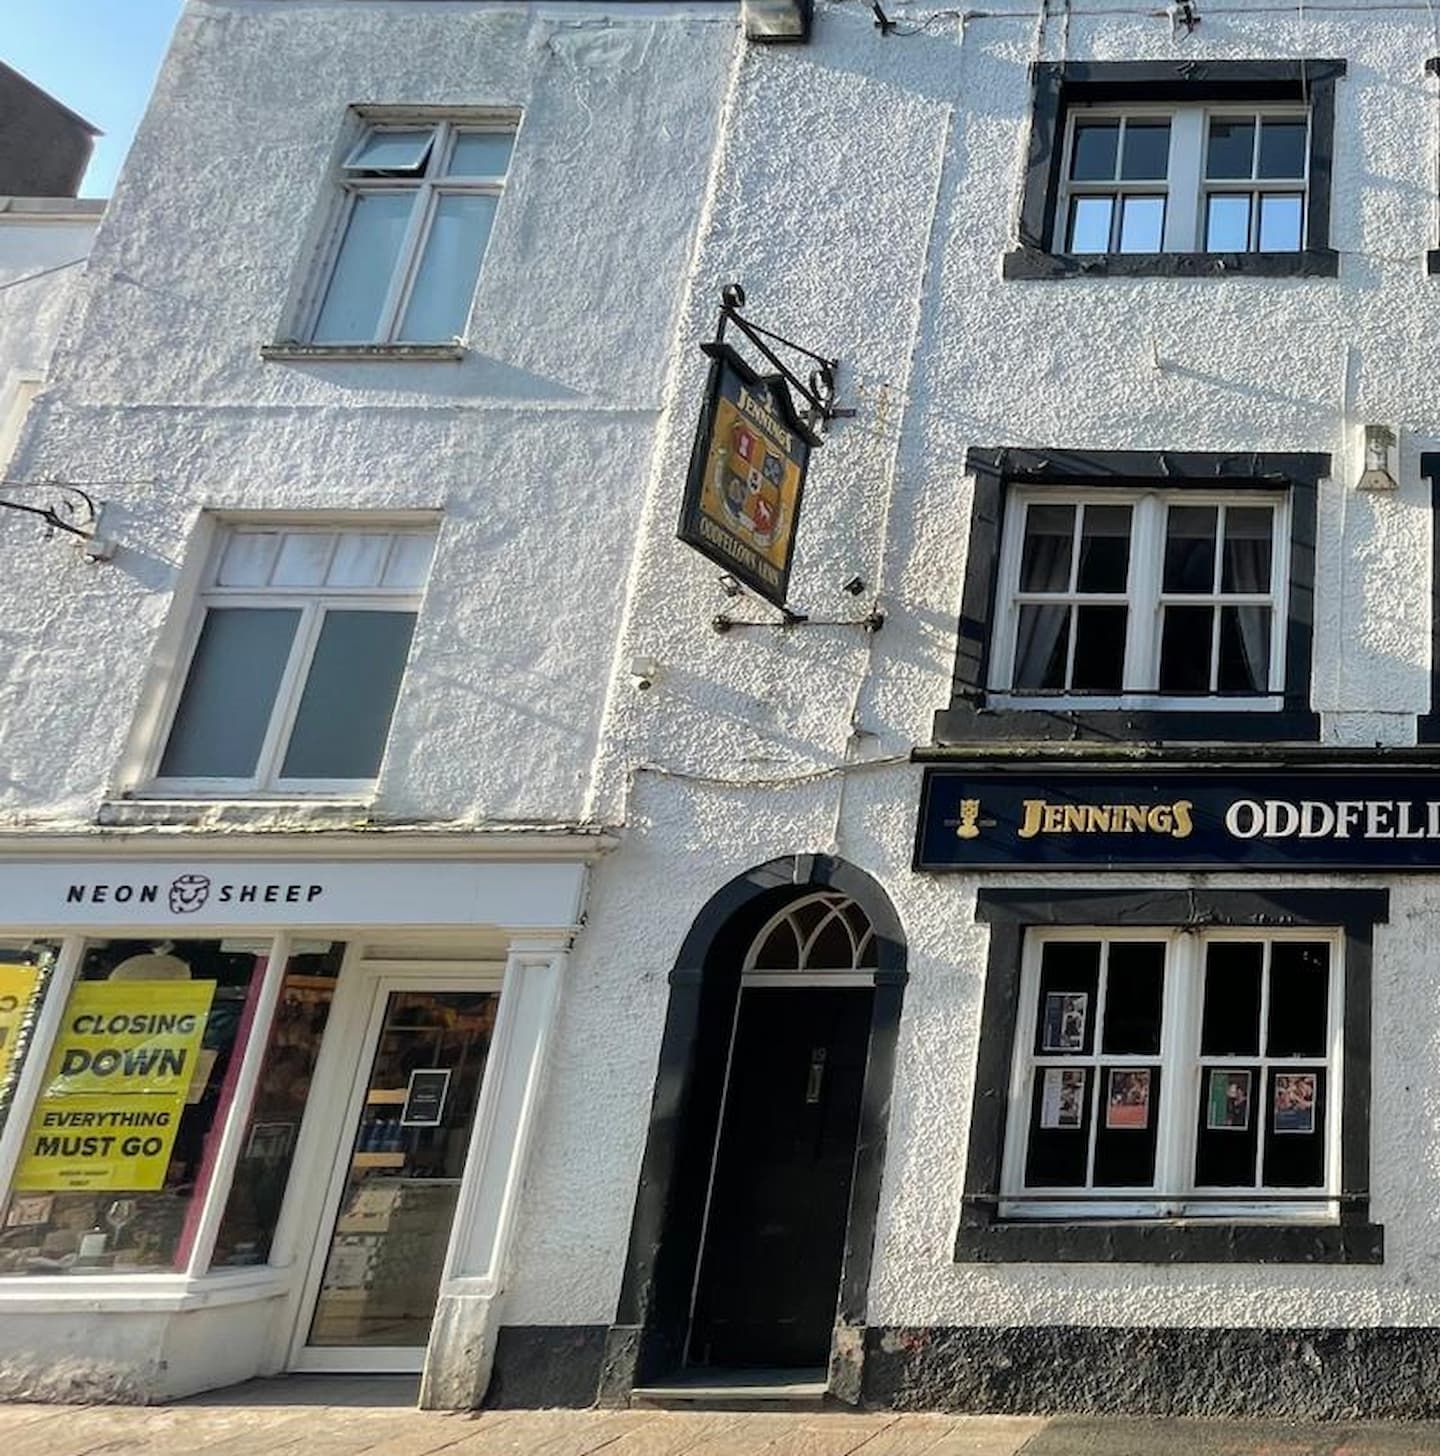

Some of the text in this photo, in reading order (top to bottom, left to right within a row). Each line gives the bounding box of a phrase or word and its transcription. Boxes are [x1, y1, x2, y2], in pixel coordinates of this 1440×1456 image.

[737, 387, 793, 453] JENNINGS
[1018, 799, 1193, 839] JENNINGS
[66, 884, 324, 903] NEON SHEEP
[72, 1014, 197, 1036] CLOSING
[61, 1048, 188, 1077] DOWN
[42, 1111, 171, 1128] EVERYTHING
[34, 1136, 164, 1158] MUST GO
